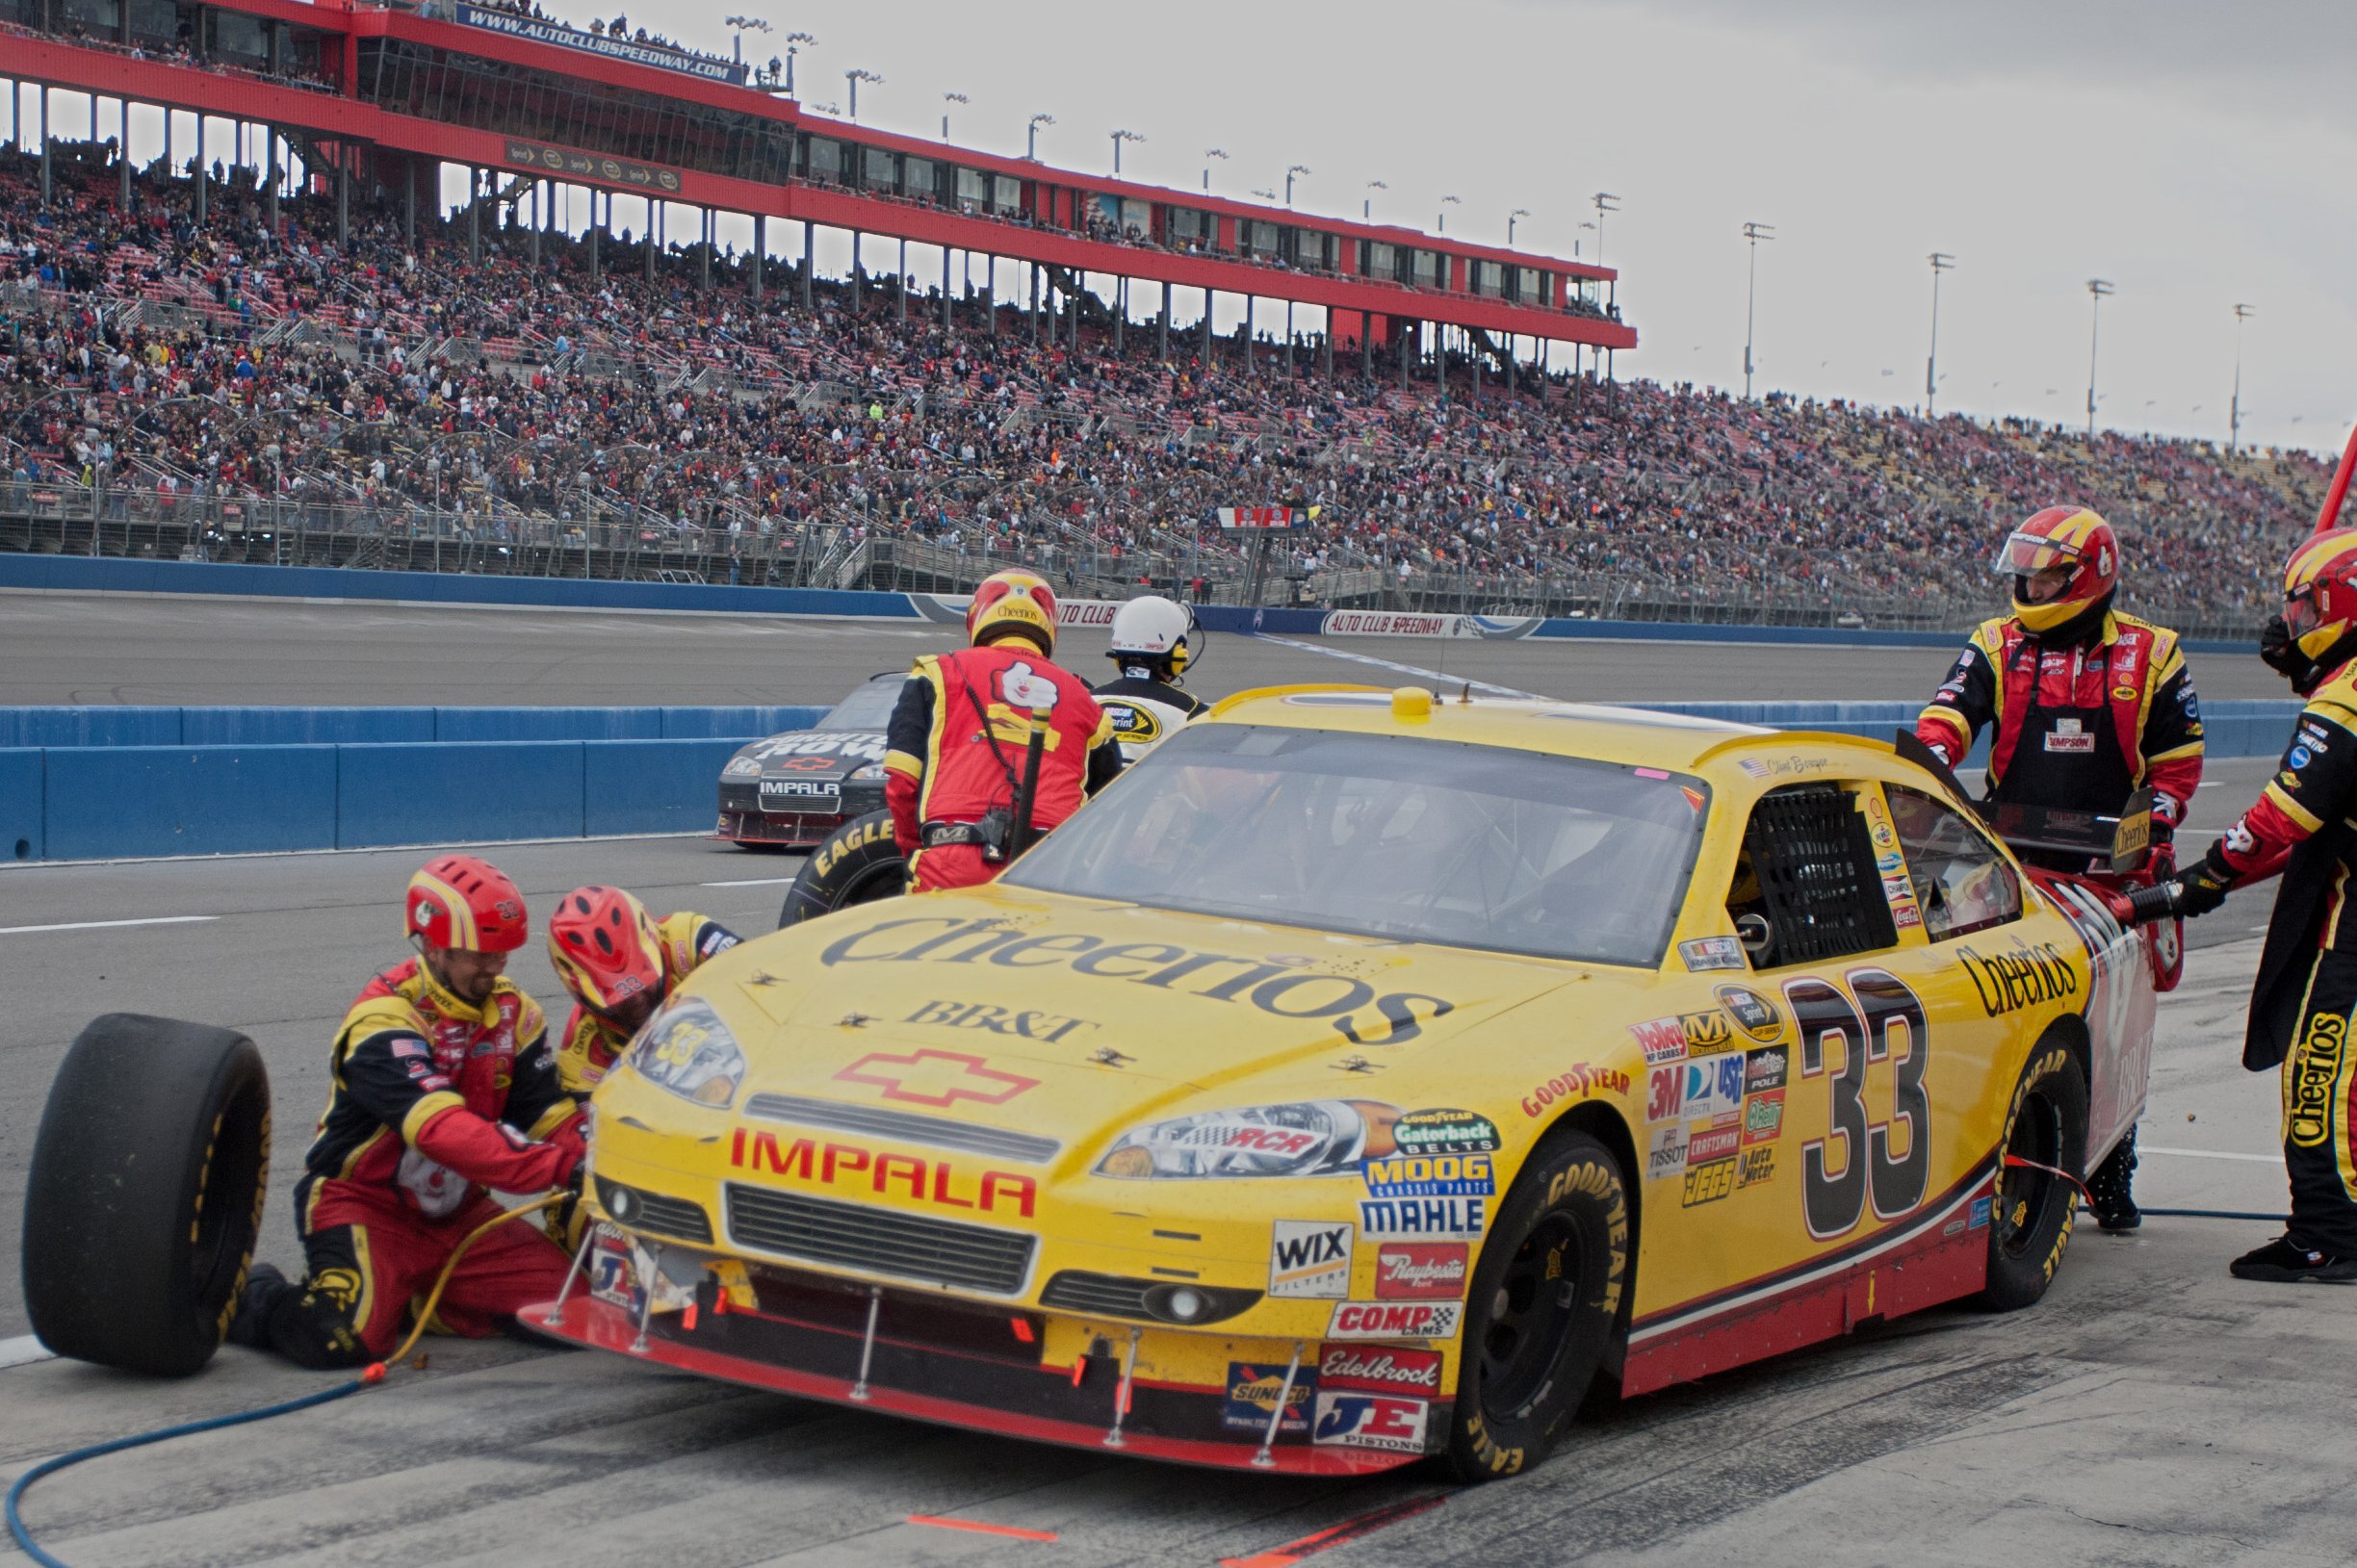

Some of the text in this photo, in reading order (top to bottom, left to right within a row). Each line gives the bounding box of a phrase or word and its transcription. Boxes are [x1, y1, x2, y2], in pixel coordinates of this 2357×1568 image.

[470, 10, 729, 80] WWW.AUTOCLUBSPEEDWAY.COM
[997, 604, 1038, 620] Cheerios
[1056, 604, 1117, 625] UTO CLUB
[1331, 613, 1446, 635] AUTO CLUB SPEEDWAY
[2049, 735, 2089, 749] SIMPSON
[759, 782, 840, 795] IMPALA
[815, 819, 894, 878] EAGLE
[2117, 821, 2148, 854] Cheerios
[614, 975, 645, 996] 33
[820, 916, 1454, 1046] Cheerios
[1956, 938, 2077, 1017] Cheerios
[903, 1000, 1104, 1044] BB&T
[656, 1022, 710, 1067] 33
[1632, 1022, 1687, 1055] Holley
[1521, 1062, 1631, 1118] GOODYEAR
[1647, 1066, 1684, 1120] 3M
[1718, 1055, 1745, 1104] USG
[1751, 1076, 1779, 1089] POLE
[2292, 1015, 2344, 1143] Cheerios
[1401, 1110, 1474, 1124] GOODYEAR
[1783, 967, 1931, 1242] 33
[1226, 1127, 1315, 1155] RCR
[1392, 1122, 1492, 1144] Gatorback
[1406, 1140, 1493, 1154] BELTS
[1691, 1131, 1741, 1156] CRAFTSMAN
[1367, 1155, 1490, 1186] MOOG
[1649, 1144, 1688, 1169] TISSOT
[1749, 1147, 1773, 1166] Auto
[730, 1127, 1038, 1219] IMPALA
[1375, 1181, 1493, 1196] CHASSIS PARTS
[1360, 1199, 1484, 1233] MAHLE
[1276, 1227, 1348, 1271] WIX
[2043, 1191, 2079, 1284] EAGLE
[1273, 1269, 1347, 1293] FILTERS
[1380, 1253, 1465, 1287] Raybestos
[1336, 1305, 1433, 1332] COMP
[1401, 1325, 1444, 1337] CAMS
[1322, 1350, 1438, 1388] Edelbrock
[1316, 1396, 1421, 1440] JE
[1343, 1433, 1423, 1452] PISTONS
